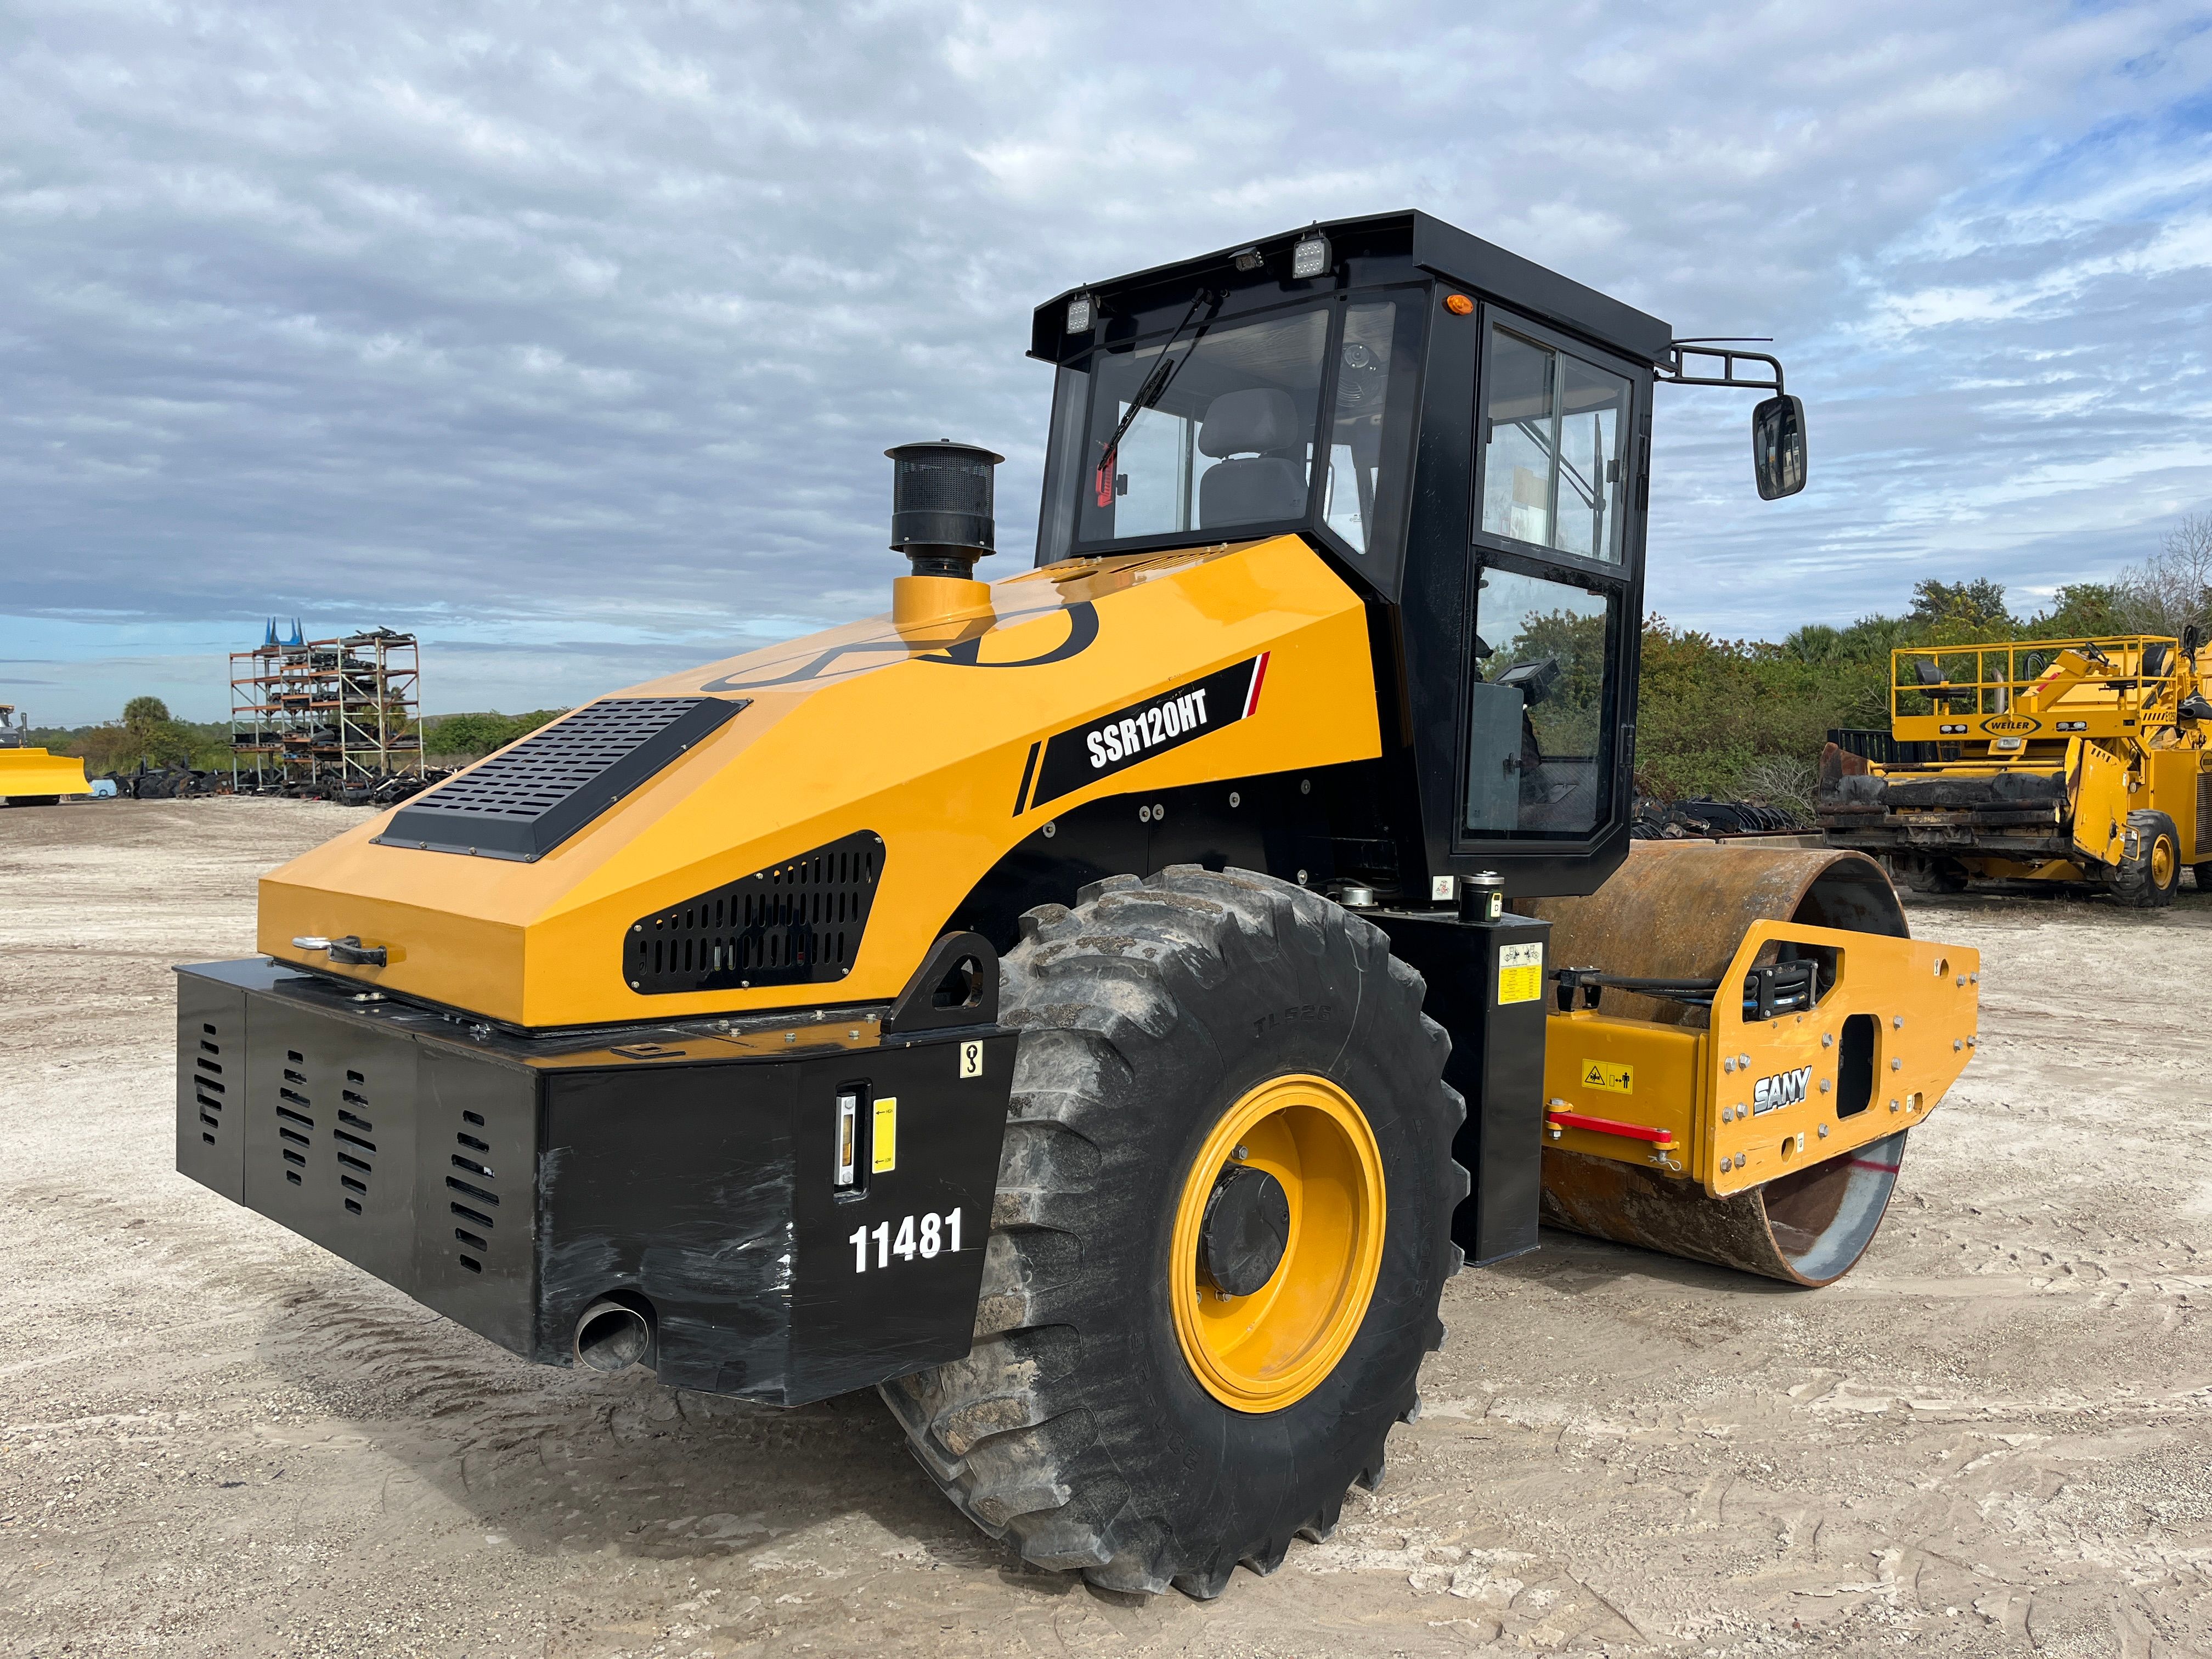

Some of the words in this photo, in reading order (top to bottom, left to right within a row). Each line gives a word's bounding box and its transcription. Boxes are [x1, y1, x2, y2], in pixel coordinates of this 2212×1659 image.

[1087, 689, 1208, 769] SSR120HT
[1753, 1065, 1813, 1117] SANY
[849, 1207, 962, 1273] 11481
[1412, 1138, 1436, 1299] TRIANGLE
